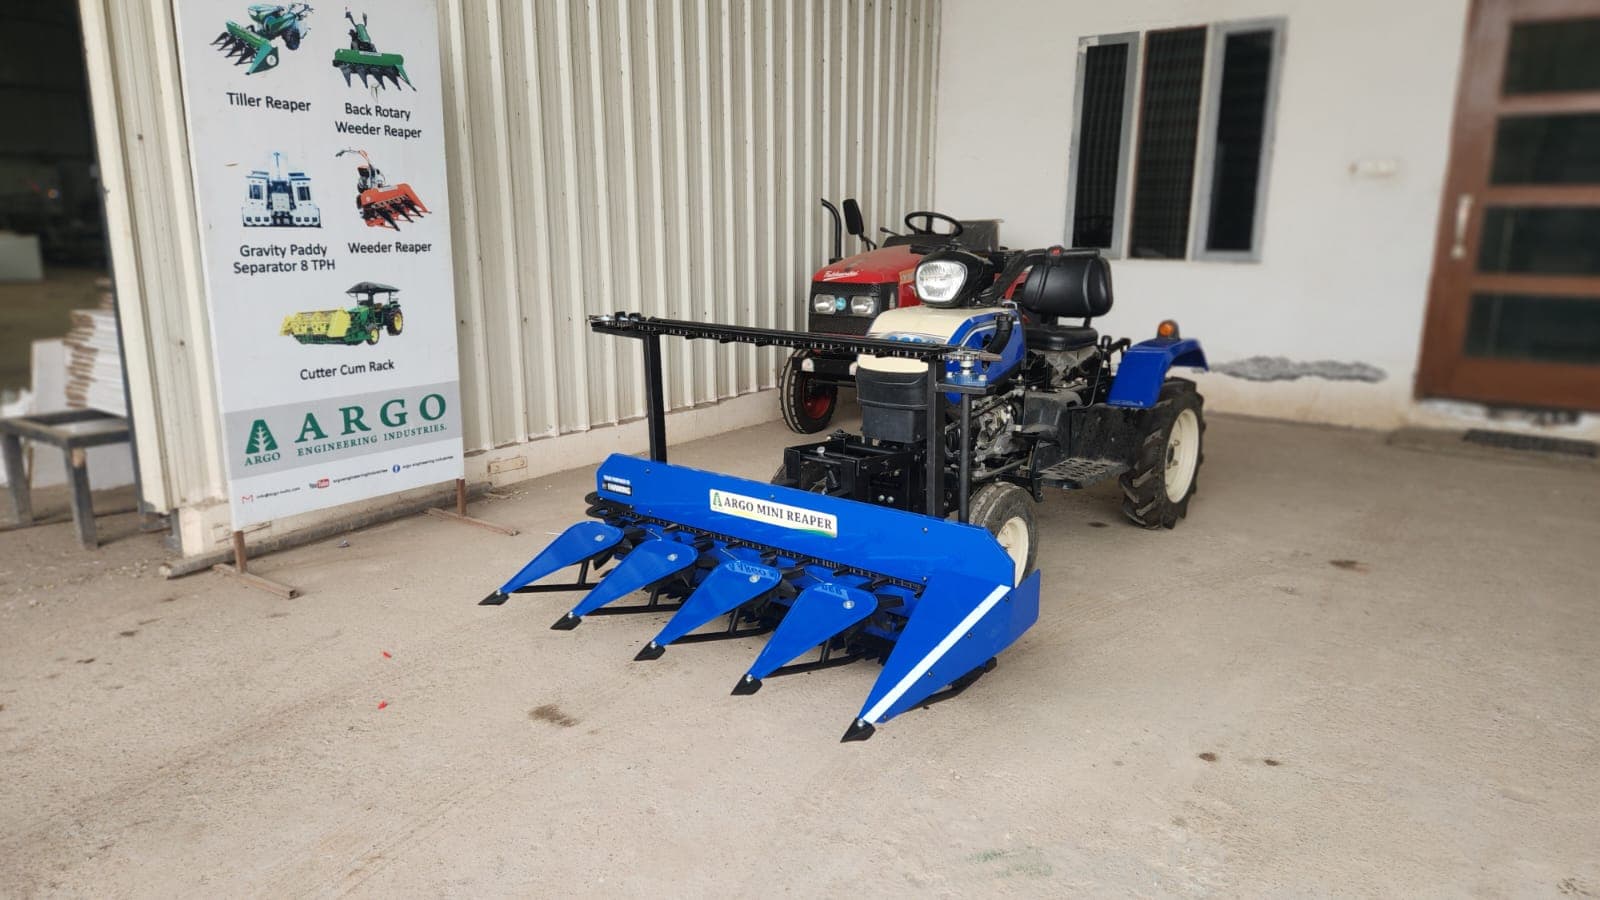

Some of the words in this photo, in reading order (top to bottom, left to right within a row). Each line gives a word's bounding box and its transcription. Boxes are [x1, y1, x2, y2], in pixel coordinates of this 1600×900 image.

[226, 92, 262, 107] Tiller
[266, 96, 311, 113] Reaper
[345, 103, 372, 116] Back
[375, 105, 411, 121] Rotary
[335, 121, 380, 136] Weeder
[384, 125, 422, 139] Reaper
[240, 244, 287, 258] Gravity
[291, 244, 327, 256] Paddy
[348, 242, 392, 254] Weeder
[395, 242, 432, 254] Reaper
[233, 261, 297, 276] Separator
[300, 260, 309, 272] 8
[311, 259, 335, 271] TPH
[300, 367, 337, 380] Cutter
[340, 364, 366, 376] Cum
[369, 360, 395, 372] Rack
[294, 393, 447, 444] ARGO
[297, 435, 378, 457] ENGINEERING
[244, 451, 281, 466] ARGO
[724, 496, 754, 512] ARGO
[757, 505, 783, 519] MINI
[787, 510, 832, 530] REAPER
